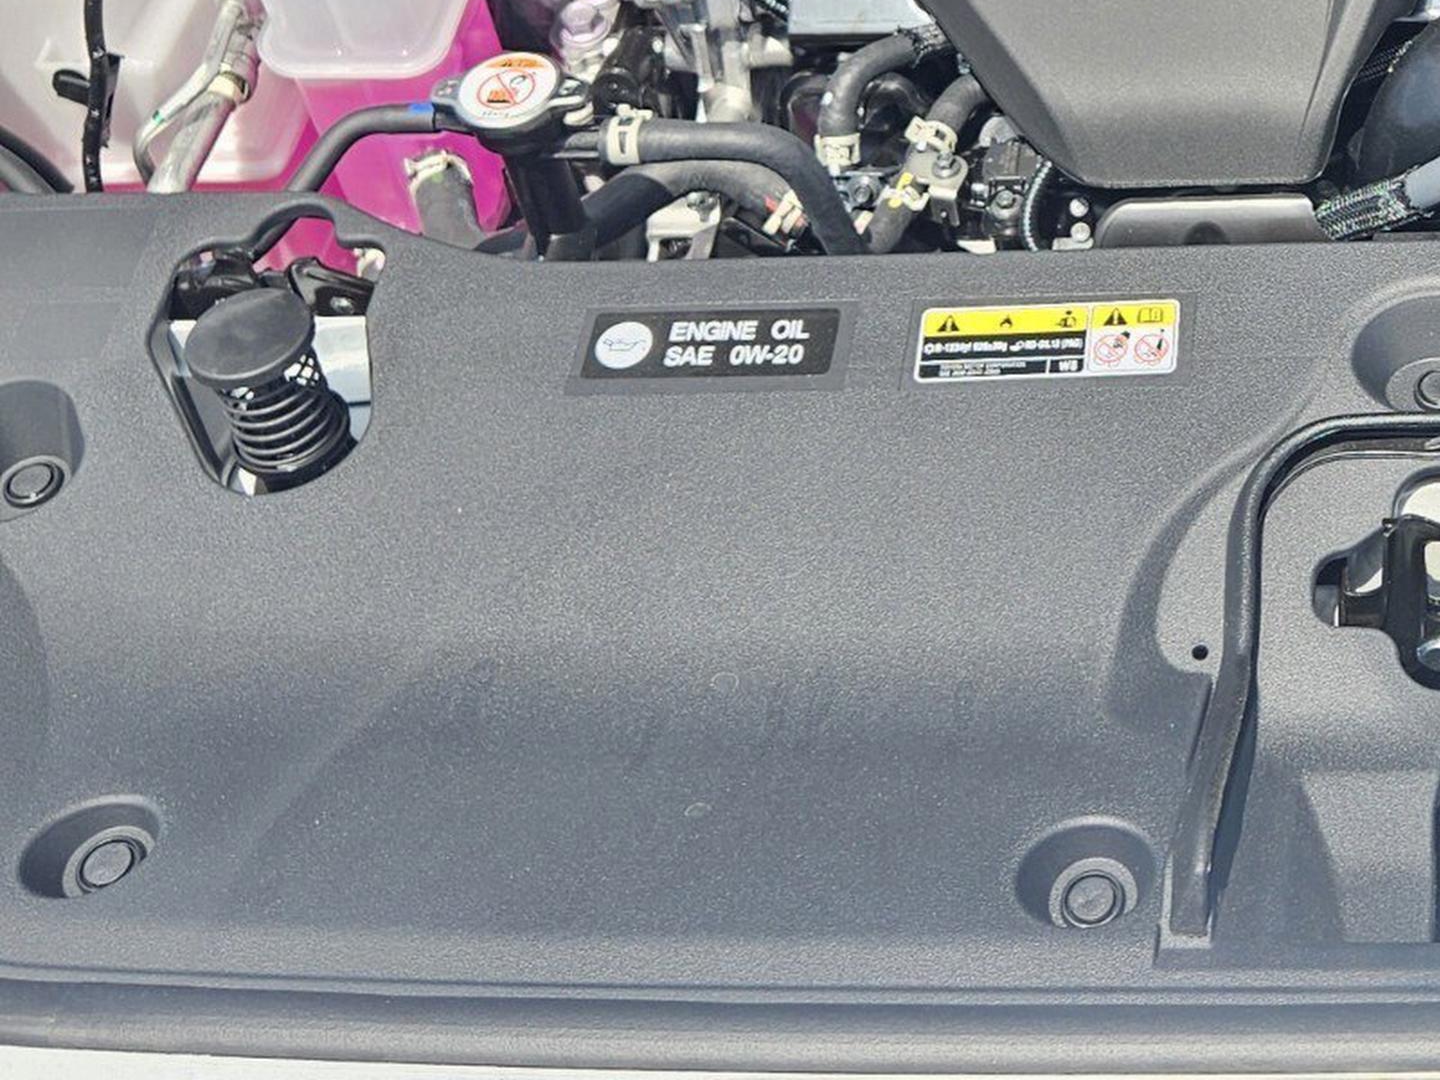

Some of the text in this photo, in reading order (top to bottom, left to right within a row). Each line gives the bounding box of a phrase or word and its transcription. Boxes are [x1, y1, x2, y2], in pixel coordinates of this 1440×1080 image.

[669, 319, 810, 342] ENGINE OIL
[663, 344, 805, 367] SAE 0W-20
